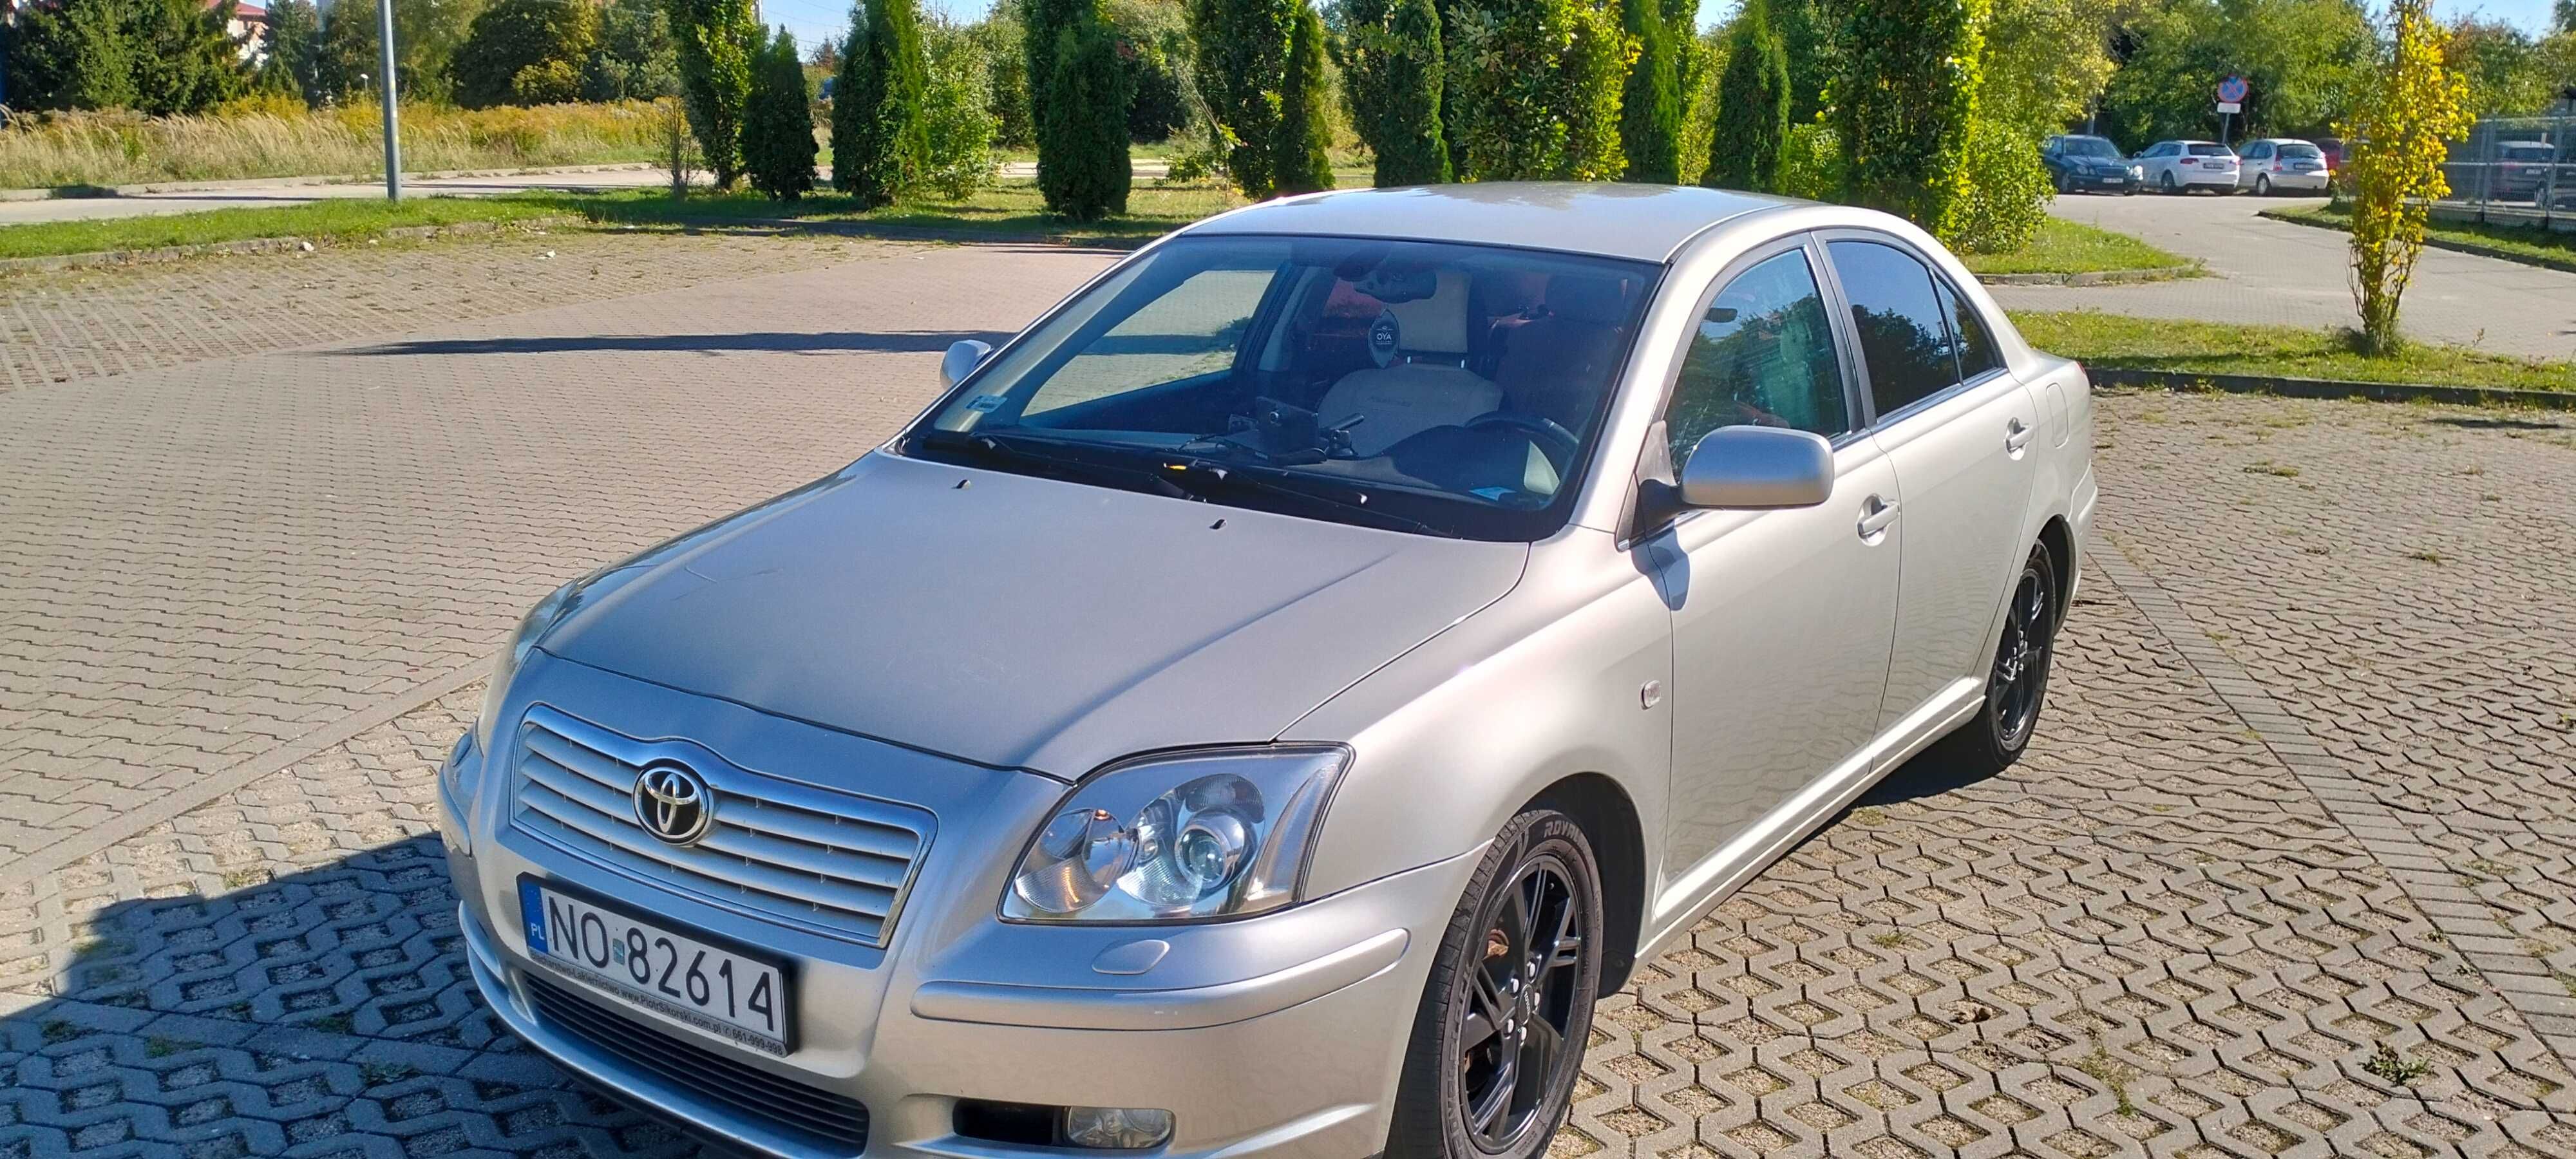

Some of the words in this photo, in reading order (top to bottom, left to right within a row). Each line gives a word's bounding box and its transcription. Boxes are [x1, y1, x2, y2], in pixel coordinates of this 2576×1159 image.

[1376, 332, 1392, 341] OYA
[530, 921, 545, 940] PL
[548, 896, 609, 968] NO
[627, 927, 773, 1032] 82614
